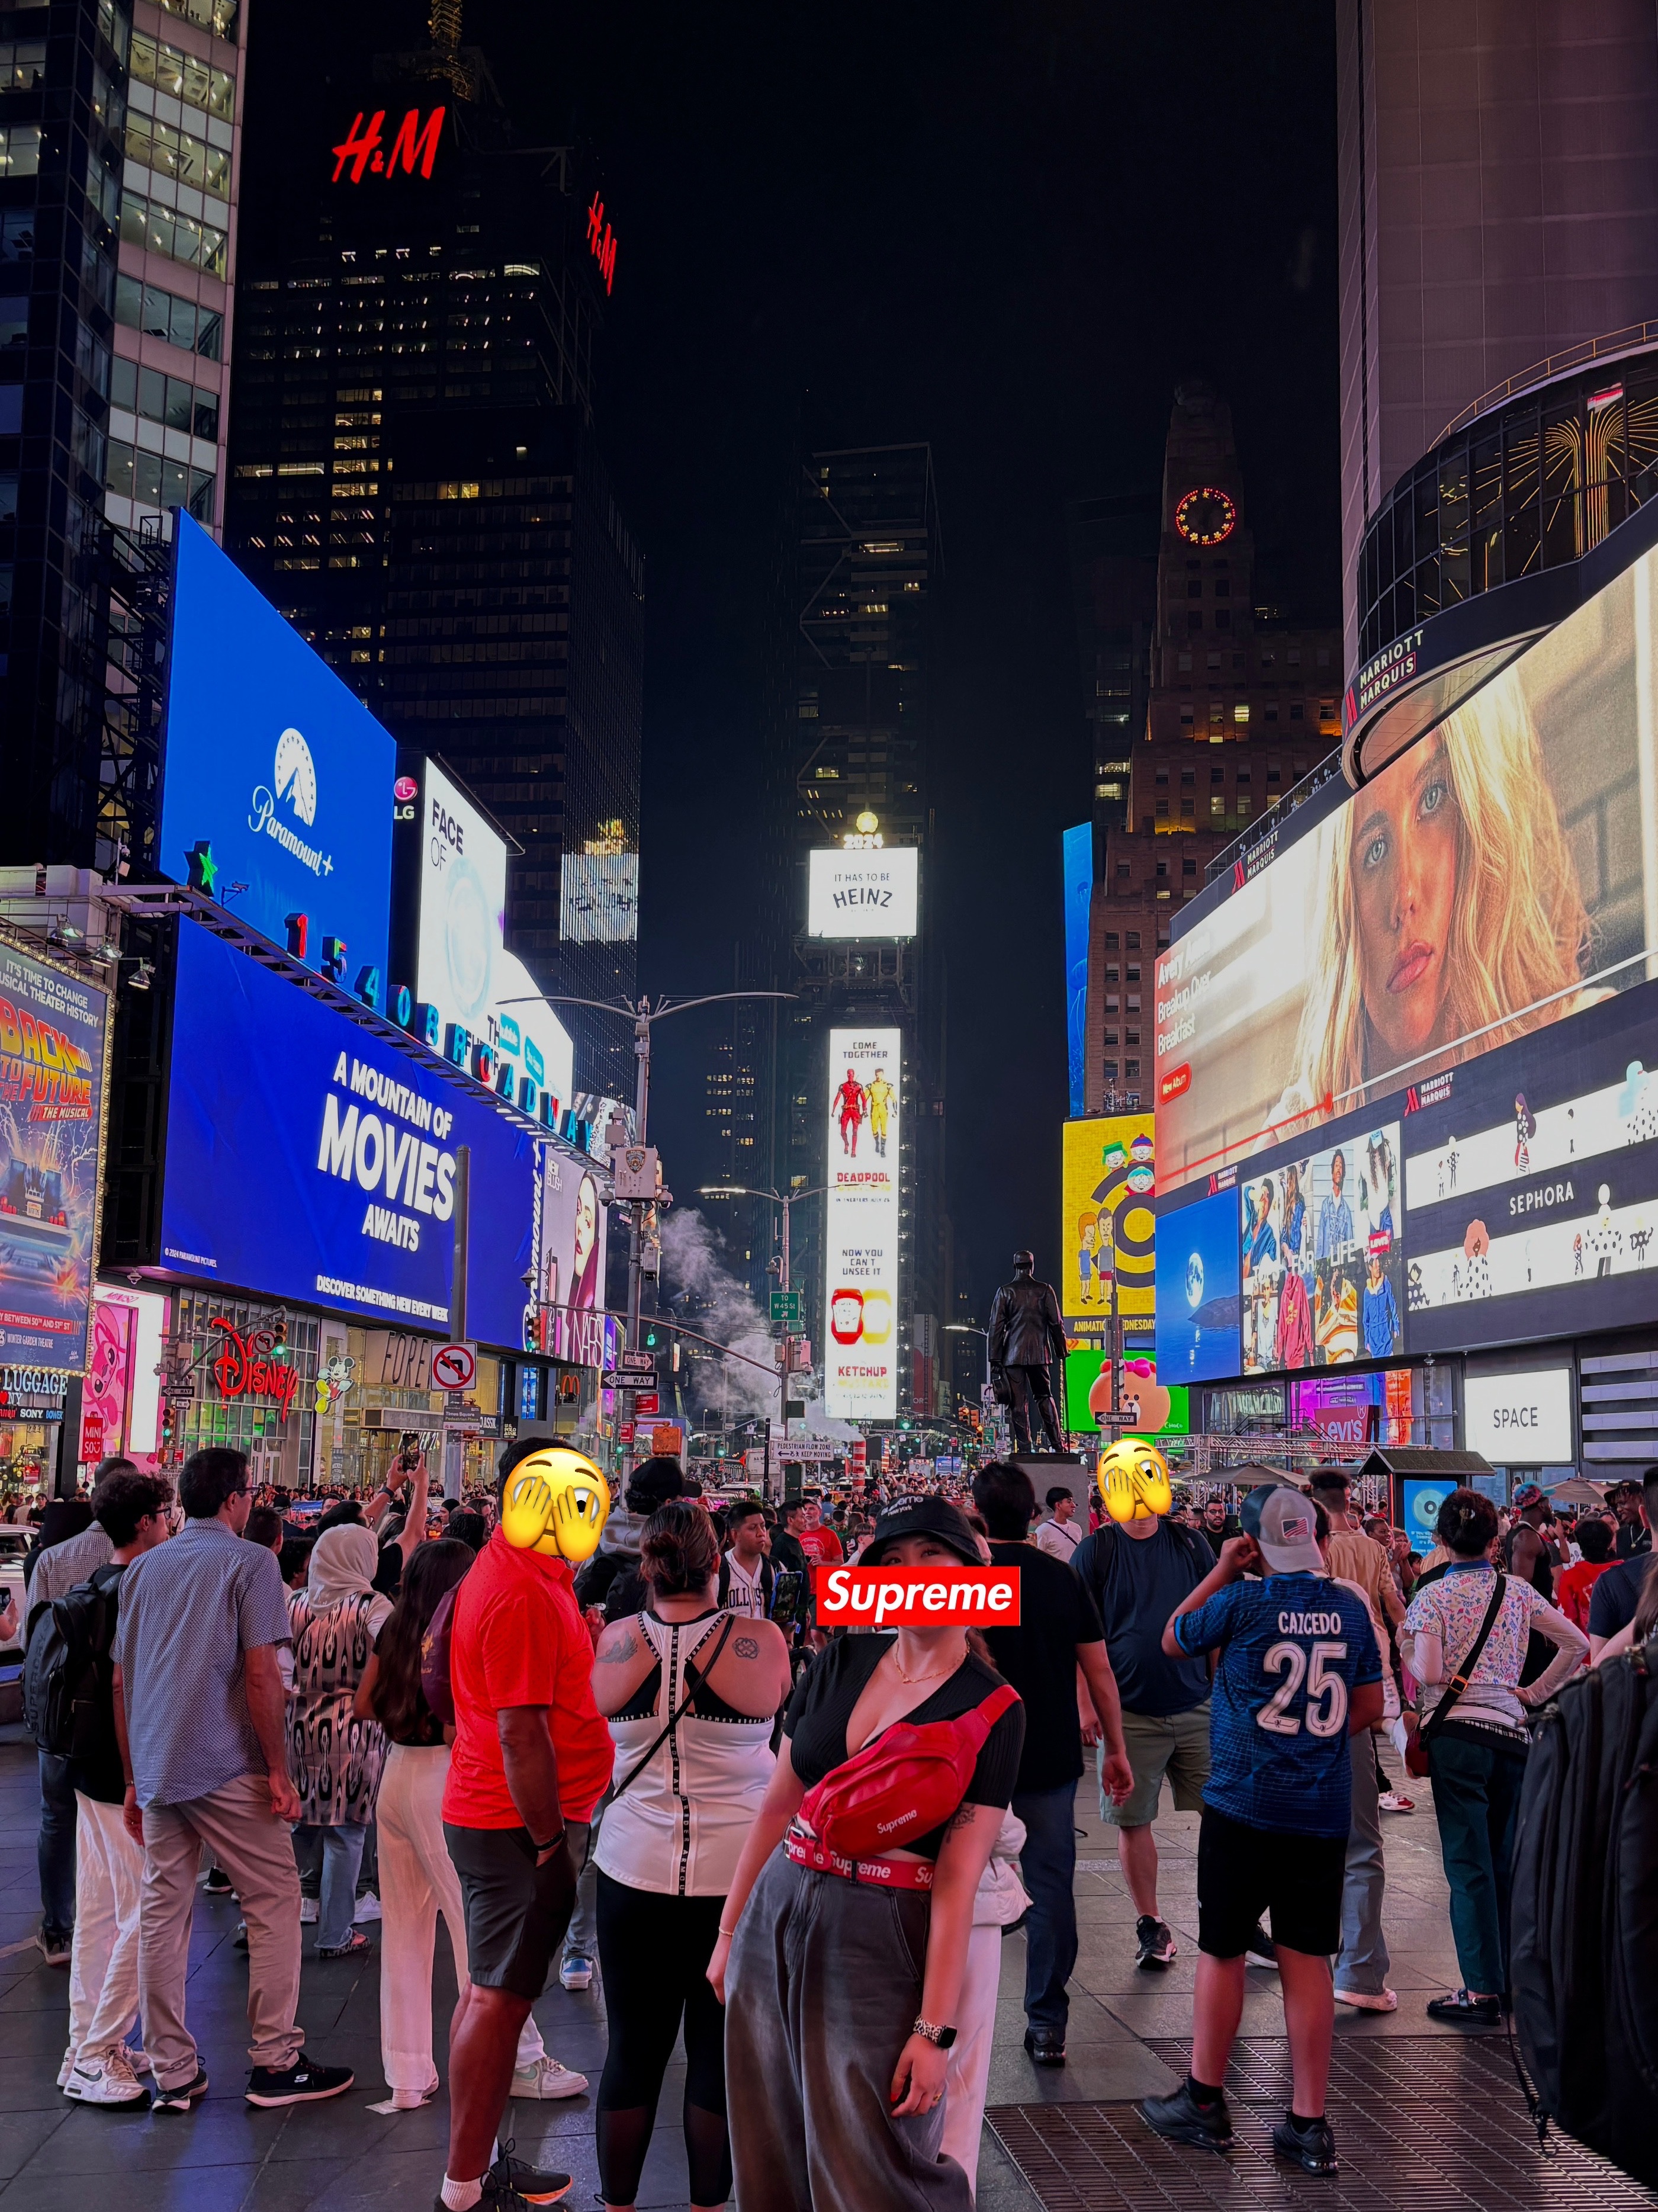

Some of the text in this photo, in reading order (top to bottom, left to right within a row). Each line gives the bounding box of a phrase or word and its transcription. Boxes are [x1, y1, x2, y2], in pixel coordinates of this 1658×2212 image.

[332, 105, 446, 184] H&M
[586, 190, 618, 296] H&M
[1360, 630, 1424, 689] MARRIOTT
[1360, 656, 1415, 710] MARQUIS
[394, 805, 415, 820] LG
[432, 797, 464, 856] FACE
[248, 785, 333, 877] Paramount+
[843, 833, 884, 849] 2024
[1247, 830, 1278, 865] MARRIOTT
[431, 836, 446, 871] OF
[1247, 848, 1275, 879] MARQUIS
[845, 874, 863, 882] HAS
[867, 873, 878, 881] TO
[881, 873, 890, 881] BE
[833, 888, 893, 908] HEINZ
[6, 959, 88, 1009] IT'S TIME TO CHANGE
[1158, 951, 1185, 989] Avery
[0, 971, 99, 1028] USICAL THEATER HISTORY
[1158, 970, 1212, 1025] Breakup Over
[0, 995, 93, 1076] BACK
[1158, 1012, 1196, 1057] Breakfast
[0, 1054, 22, 1081] TO
[18, 1061, 92, 1106] FUTURE
[1421, 1071, 1454, 1094] MARRIOTT
[42, 1106, 89, 1119] THE MUSICAL
[333, 1051, 453, 1141] A MOUNTAIN OF
[1421, 1086, 1450, 1106] MARQUIS
[317, 1093, 457, 1222] MOVIES
[837, 1172, 891, 1182] DEADPOOL
[1509, 1181, 1575, 1216] SEPHORA
[361, 1204, 420, 1253] AWAITS
[1291, 1250, 1316, 1277] FOR
[1329, 1238, 1357, 1267] LIFE
[316, 1274, 449, 1322] DISCOVER SOMETHING NEW EVERY WEEK
[4, 1313, 31, 1325] BETWEEN
[43, 1319, 54, 1328] AND
[63, 1322, 70, 1331] ST
[572, 1309, 602, 1369] NARS
[1122, 1318, 1156, 1331] DNESDAY
[7, 1333, 54, 1349] WINTER GARDEN THEATRE
[381, 1333, 430, 1389] FORE
[640, 1357, 650, 1366] WAY
[838, 1366, 888, 1377] KETCHUP
[3, 1369, 69, 1396] LUGGAGE
[609, 1376, 651, 1385] ONE WAY
[7, 1392, 24, 1405] NY
[20, 1408, 44, 1419] SONY
[85, 1426, 102, 1439] MINI
[1493, 1407, 1538, 1429] SPACE
[1278, 1611, 1342, 1635] CAICEDO
[668, 1631, 679, 1719] UNDER ARMOU
[1256, 1641, 1348, 1737] 25
[876, 1809, 917, 1835] Supreme
